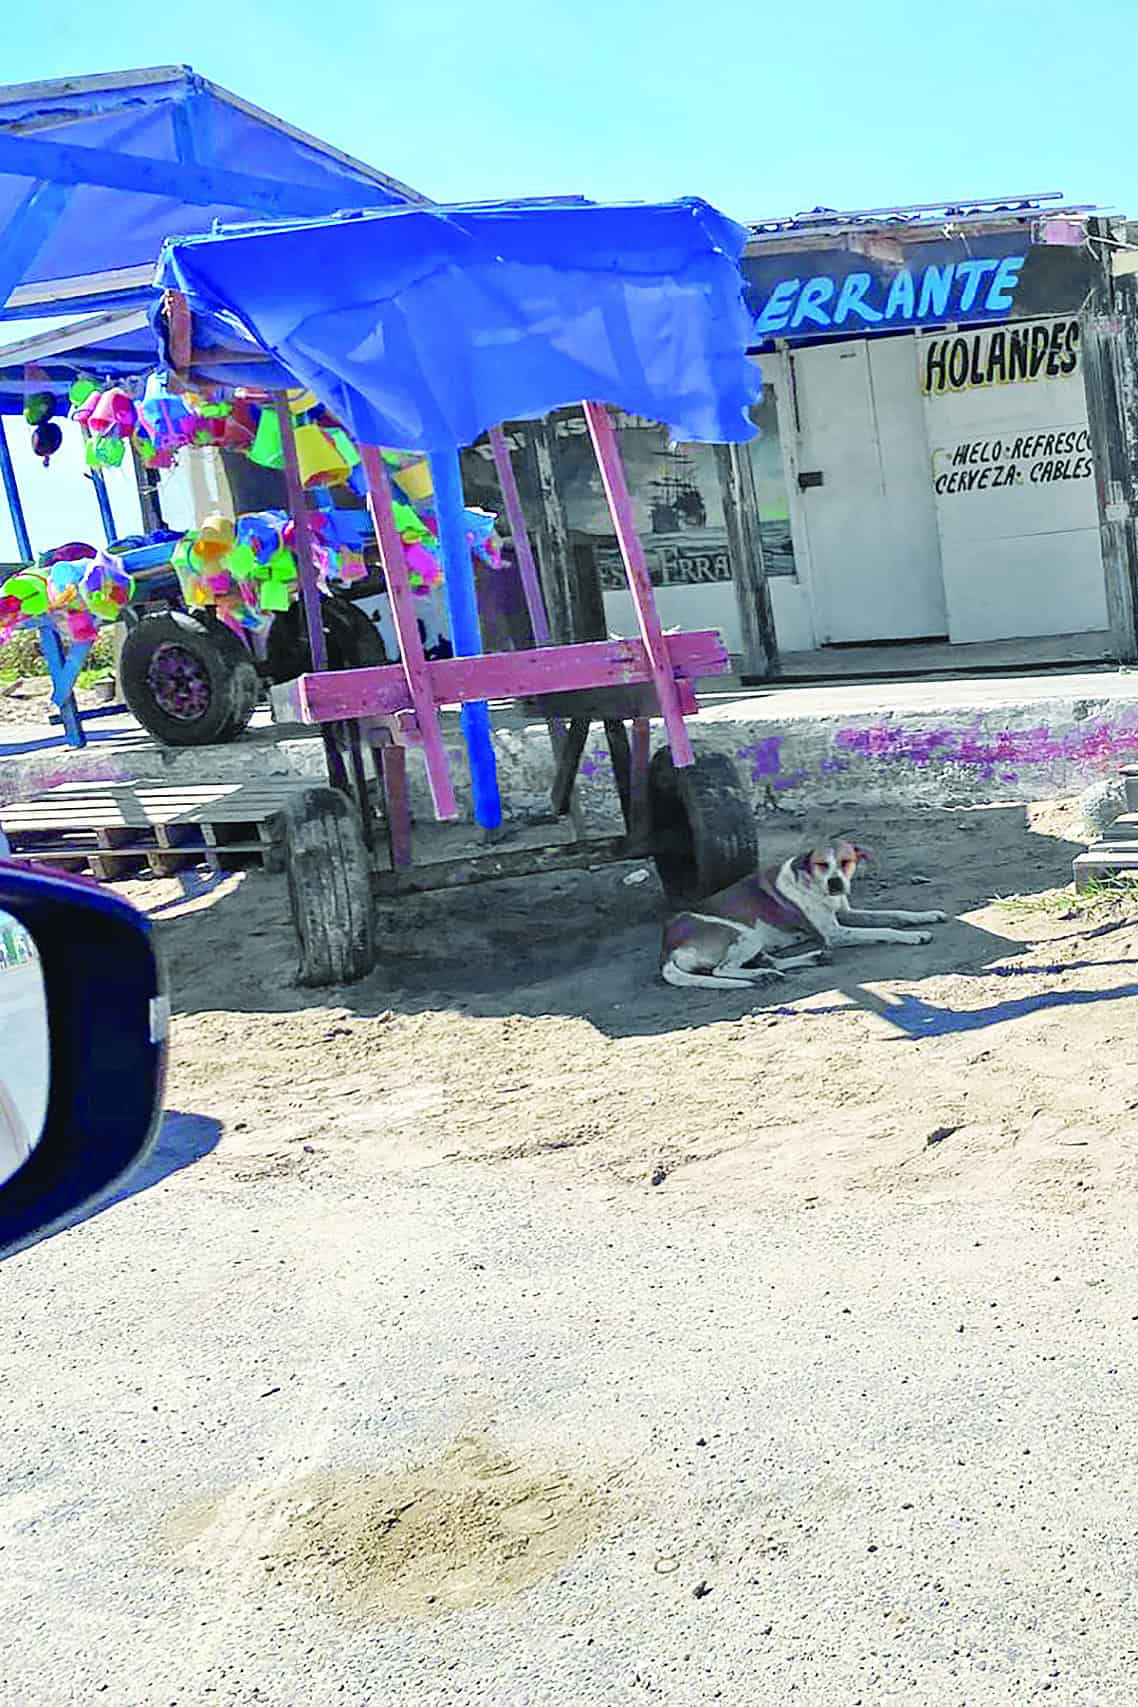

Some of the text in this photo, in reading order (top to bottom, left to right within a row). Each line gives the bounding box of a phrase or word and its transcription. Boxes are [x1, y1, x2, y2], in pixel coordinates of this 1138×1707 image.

[756, 256, 1025, 333] ERRANTE
[925, 320, 1080, 391] HOLANDES
[1030, 457, 1094, 483] CABLES
